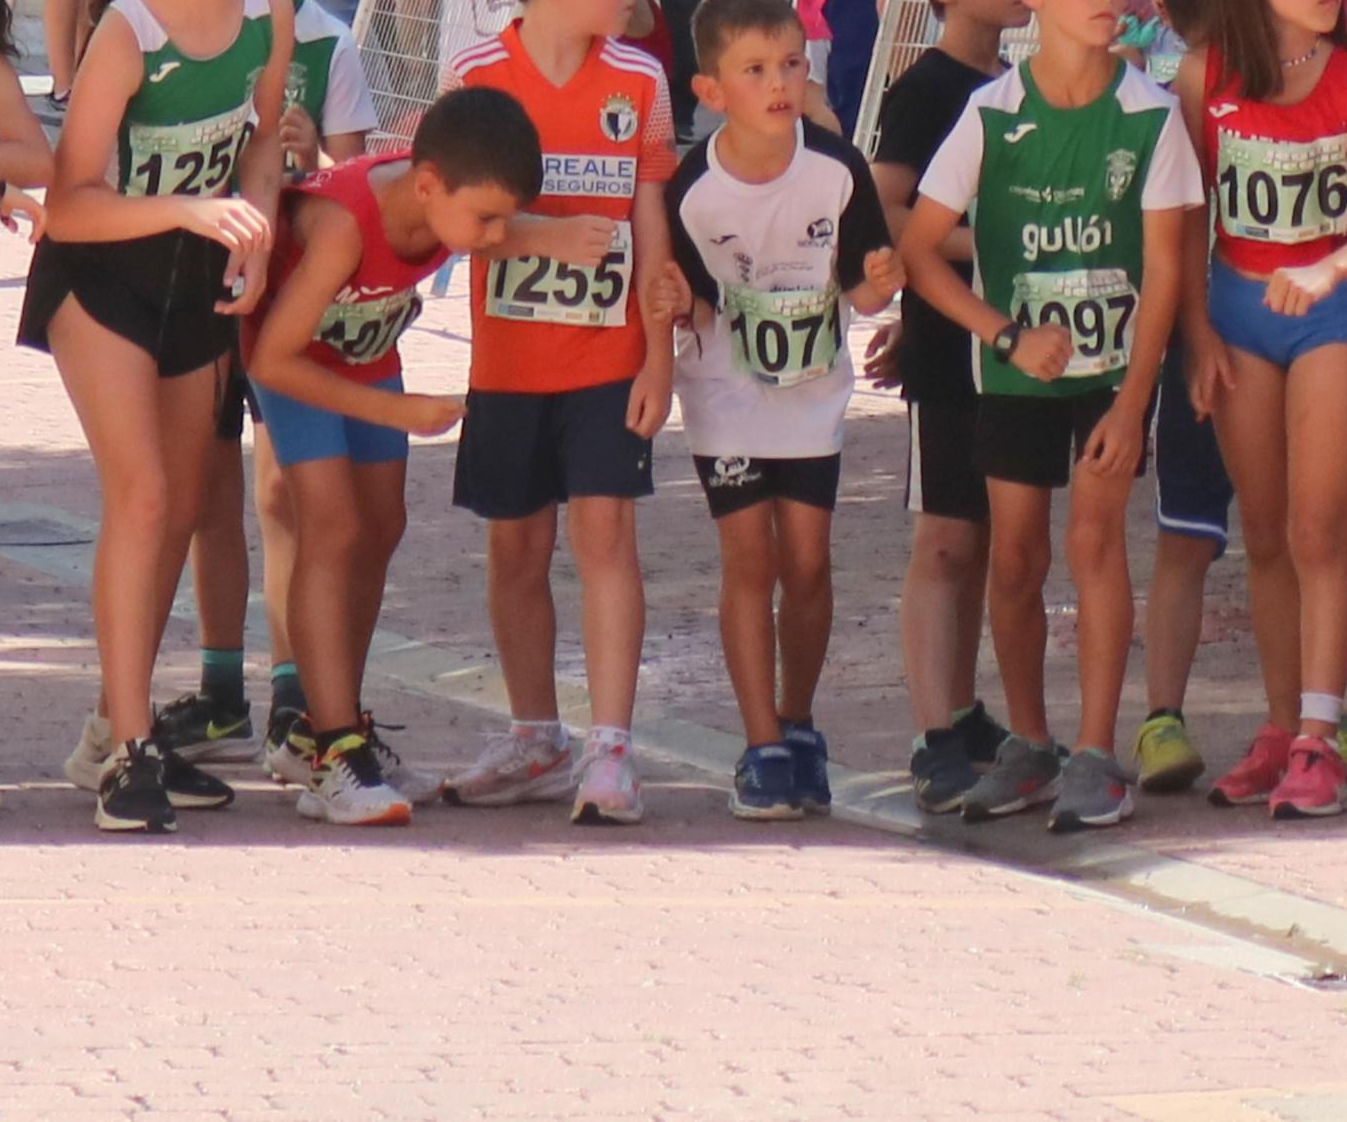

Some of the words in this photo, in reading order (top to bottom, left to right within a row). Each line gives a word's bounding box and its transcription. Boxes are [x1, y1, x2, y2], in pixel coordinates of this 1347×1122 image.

[544, 157, 634, 178] REALE
[543, 179, 633, 195] SEGUROS
[494, 250, 626, 309] 1255
